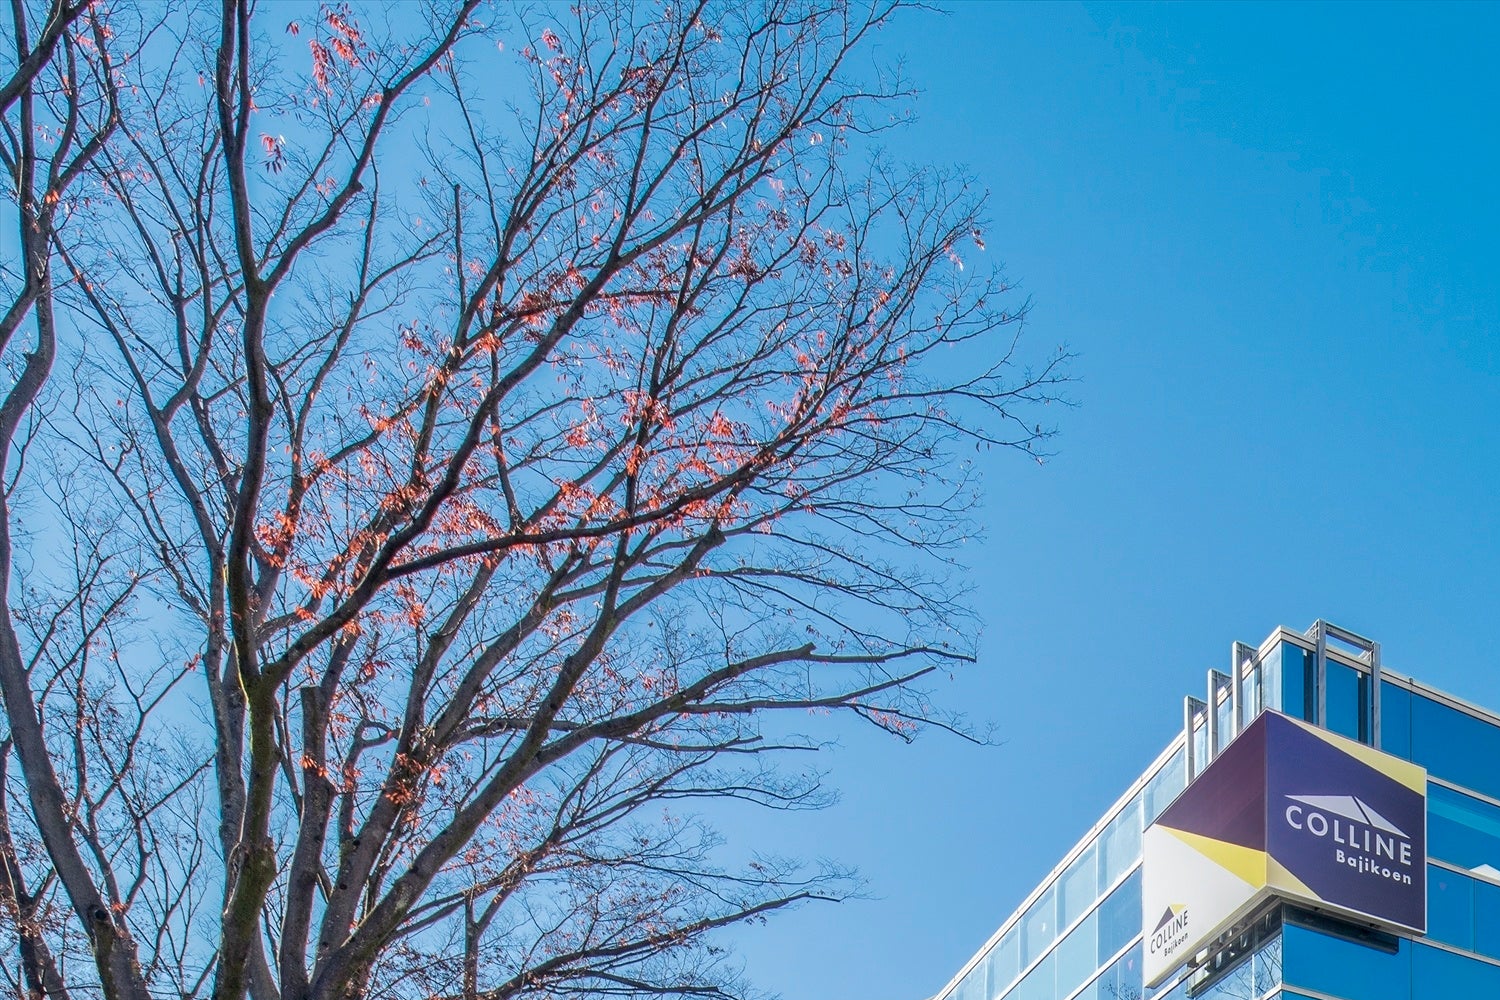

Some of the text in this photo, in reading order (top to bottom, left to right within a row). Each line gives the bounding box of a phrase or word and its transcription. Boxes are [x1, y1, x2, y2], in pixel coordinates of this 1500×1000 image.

[1285, 805, 1412, 866] COLLINE
[1336, 849, 1412, 885] Bajikoen
[1150, 910, 1188, 954] COLLINE
[1164, 932, 1188, 957] Bajikoen
